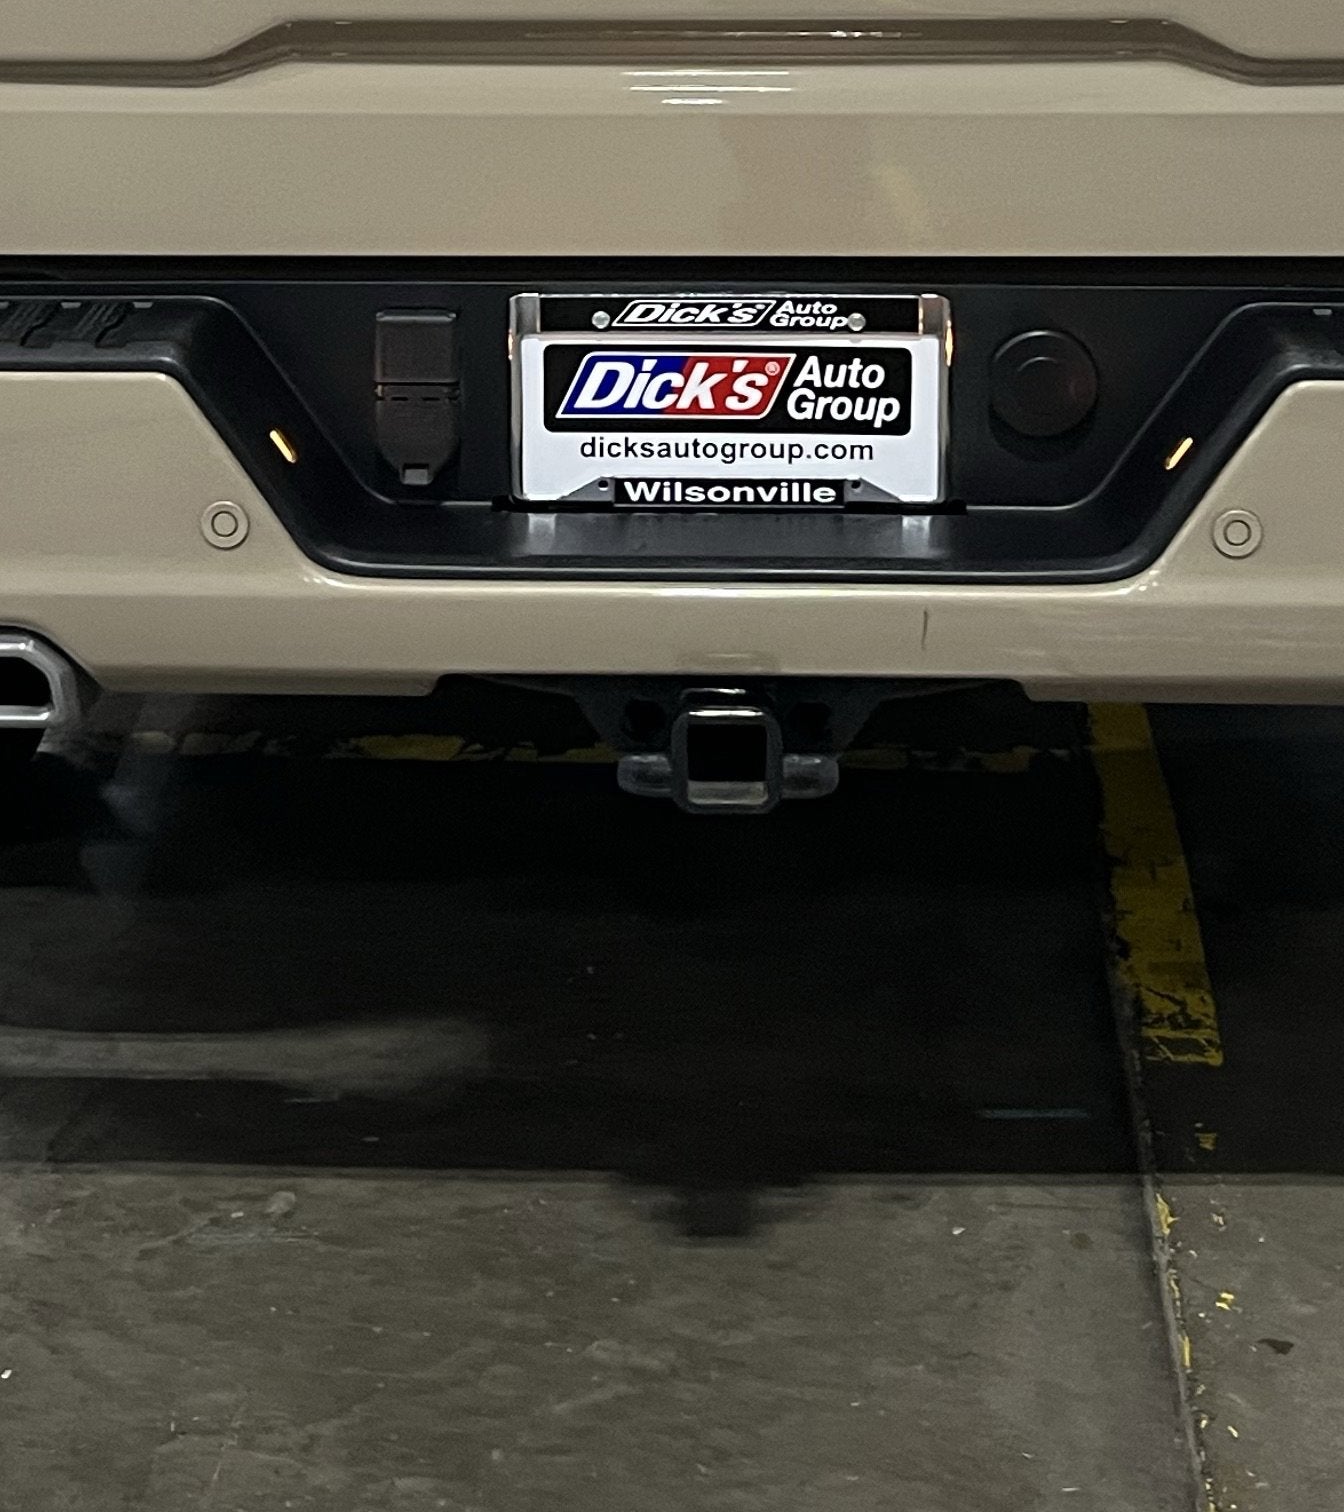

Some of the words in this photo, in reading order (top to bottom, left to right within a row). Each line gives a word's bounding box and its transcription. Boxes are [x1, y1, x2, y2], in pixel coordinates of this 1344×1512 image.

[623, 302, 765, 324] Dick's
[776, 300, 838, 315] Auto
[770, 313, 848, 330] Group
[573, 359, 764, 410] Dick's
[794, 356, 886, 388] Auto
[787, 391, 901, 427] Group
[580, 437, 874, 464] dicksautogroup.com
[624, 481, 837, 503] Wilsonville
